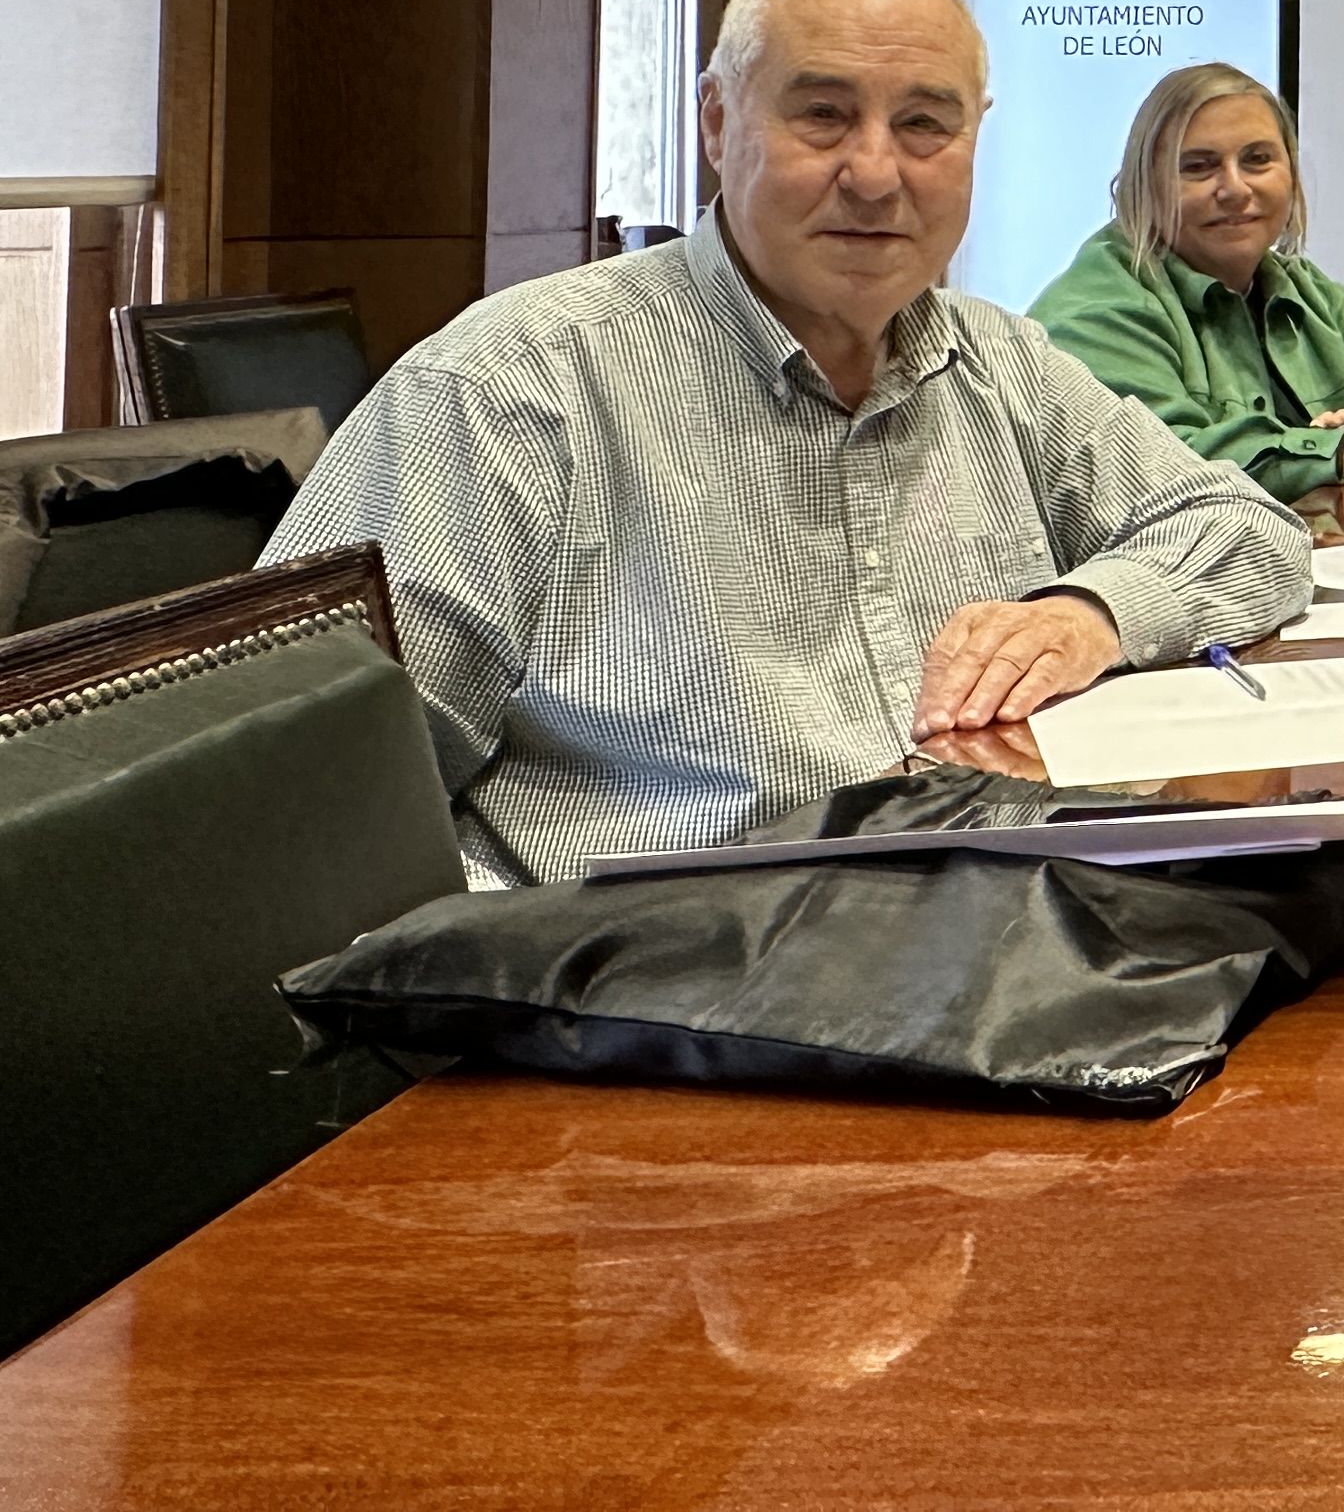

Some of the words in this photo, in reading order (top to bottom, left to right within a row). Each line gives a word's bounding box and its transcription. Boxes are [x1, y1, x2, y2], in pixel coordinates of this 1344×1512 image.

[1021, 5, 1204, 26] AYUNTAMIENTO
[1063, 35, 1096, 56] DE
[1102, 29, 1162, 57] LEÓN
